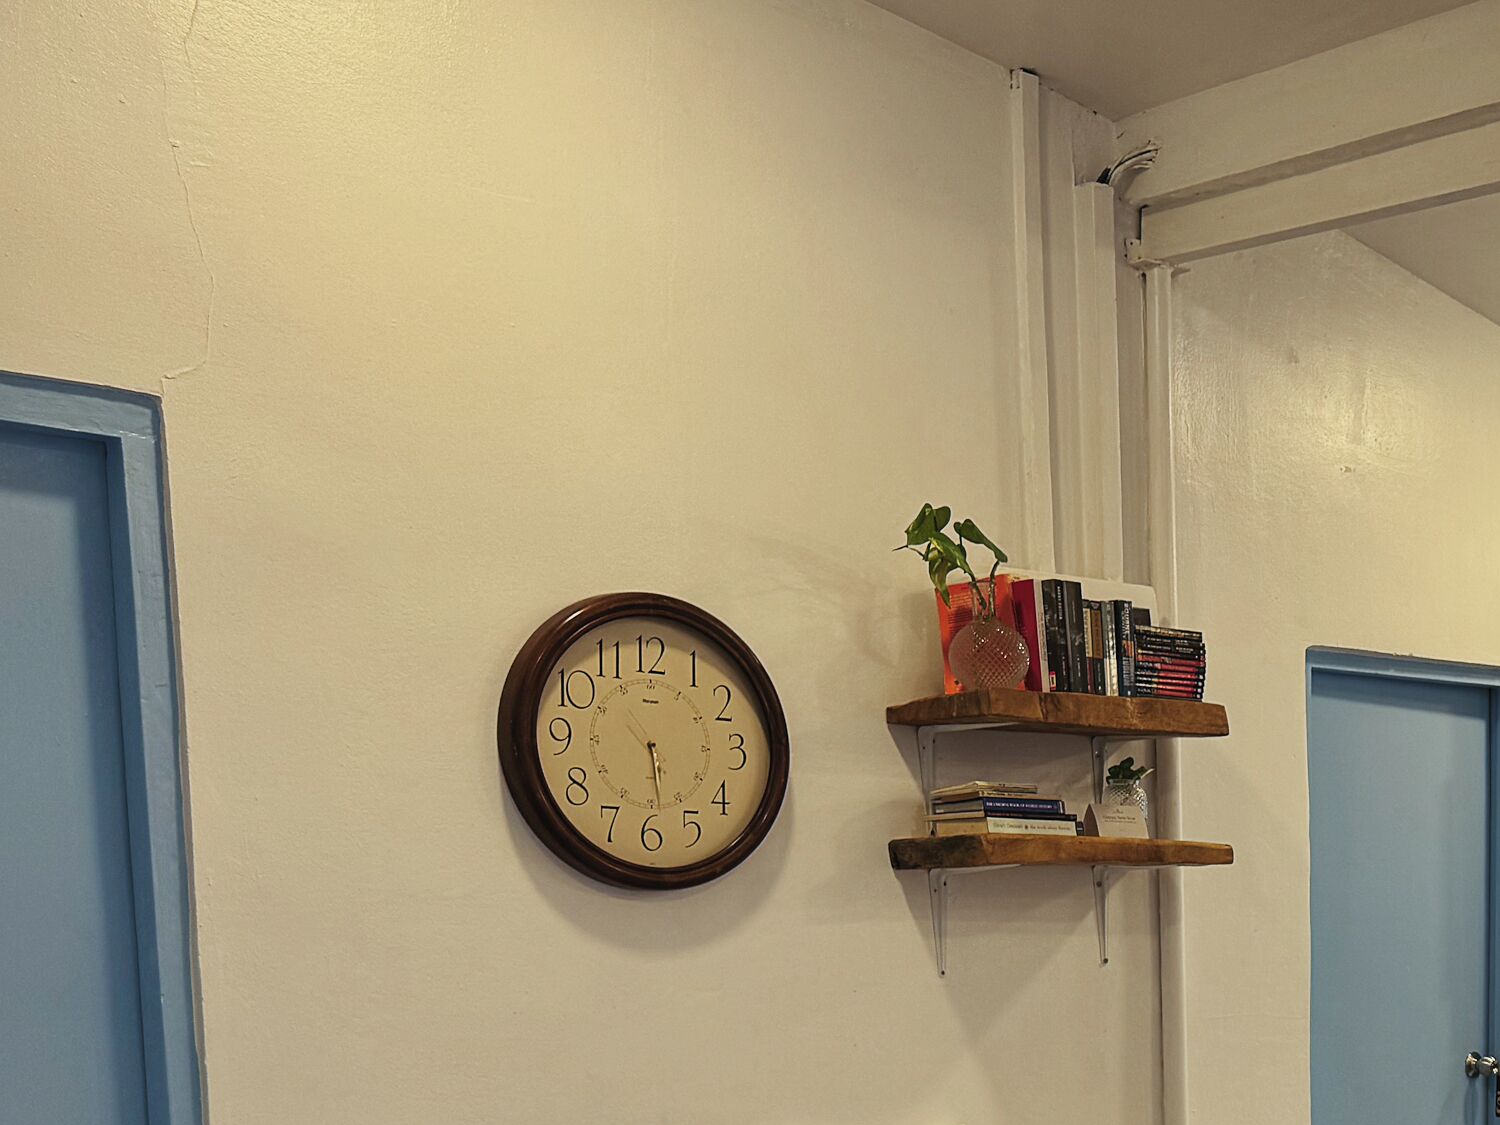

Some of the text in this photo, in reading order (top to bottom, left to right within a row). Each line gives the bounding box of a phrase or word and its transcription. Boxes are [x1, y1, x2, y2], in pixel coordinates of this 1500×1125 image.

[596, 638, 622, 679] 11
[636, 635, 665, 675] 12
[689, 650, 699, 688] 1
[557, 668, 595, 709] 10
[713, 685, 733, 722] 2
[549, 717, 572, 756] 9
[728, 733, 747, 770] 3
[566, 767, 589, 805] 8
[711, 780, 730, 815] 4
[600, 805, 621, 843] 7
[641, 814, 663, 851] 6
[683, 811, 701, 848] 5
